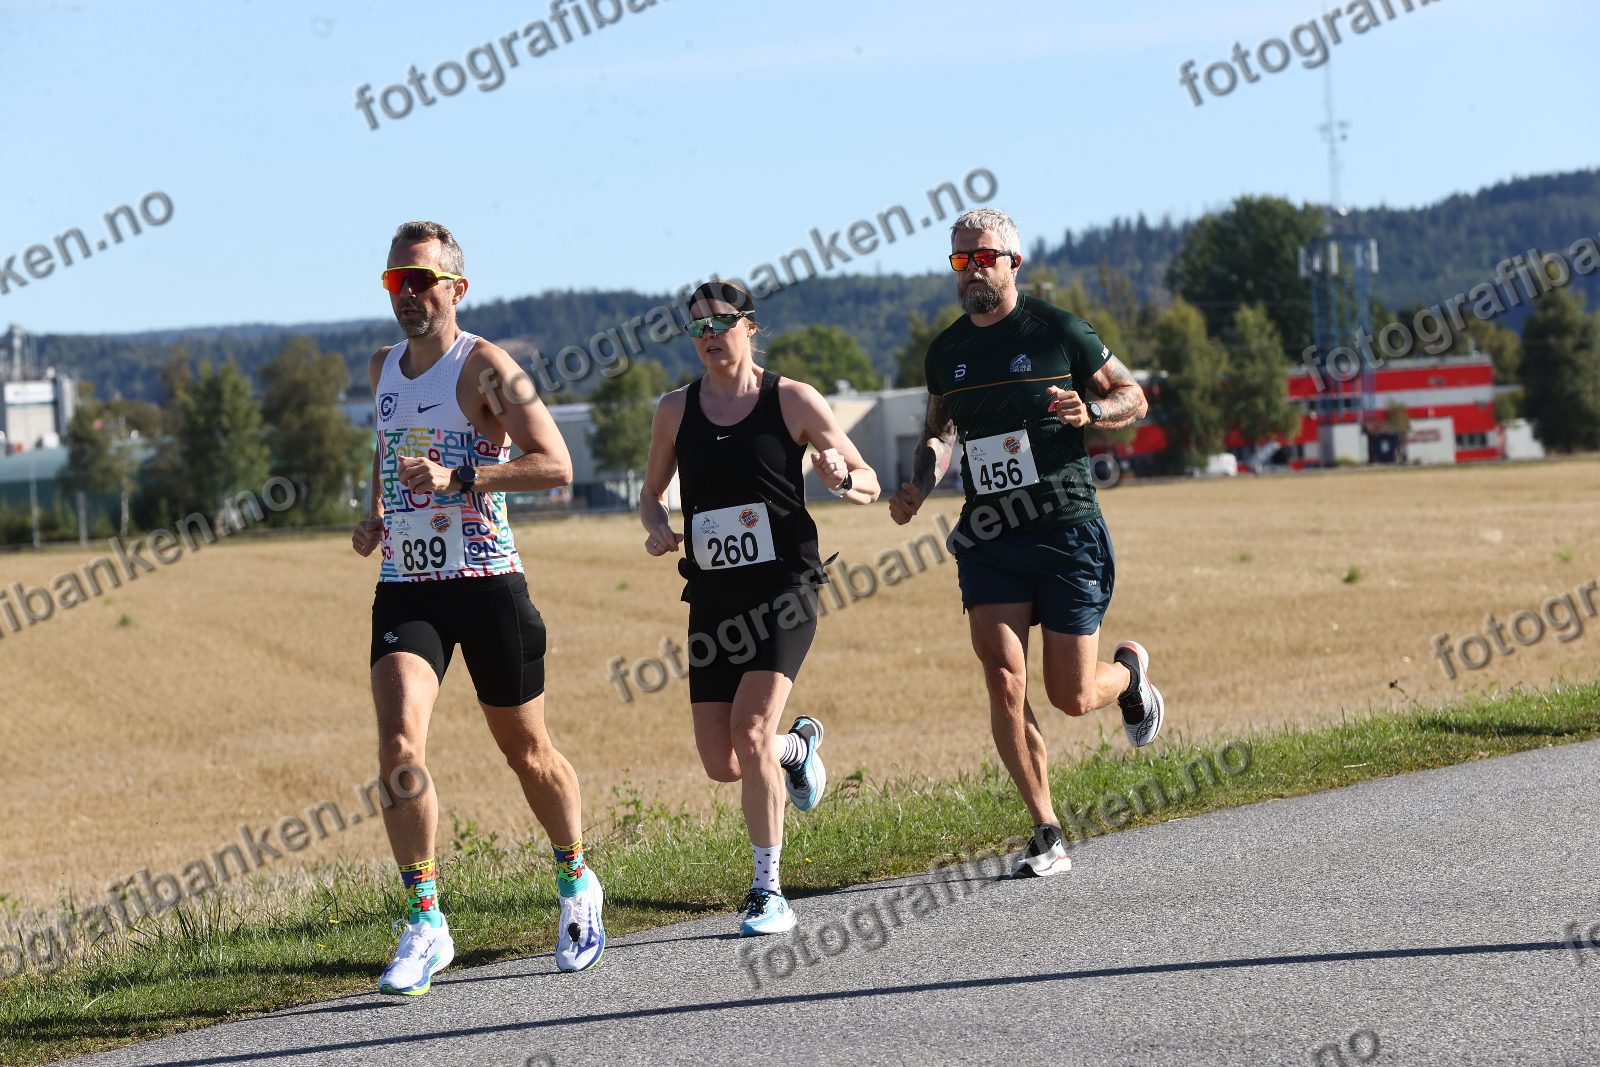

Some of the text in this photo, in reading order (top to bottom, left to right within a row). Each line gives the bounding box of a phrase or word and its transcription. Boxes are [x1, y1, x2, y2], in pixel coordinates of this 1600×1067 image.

[980, 458, 1023, 490] 456
[402, 535, 447, 572] 839
[707, 531, 759, 567] 260
